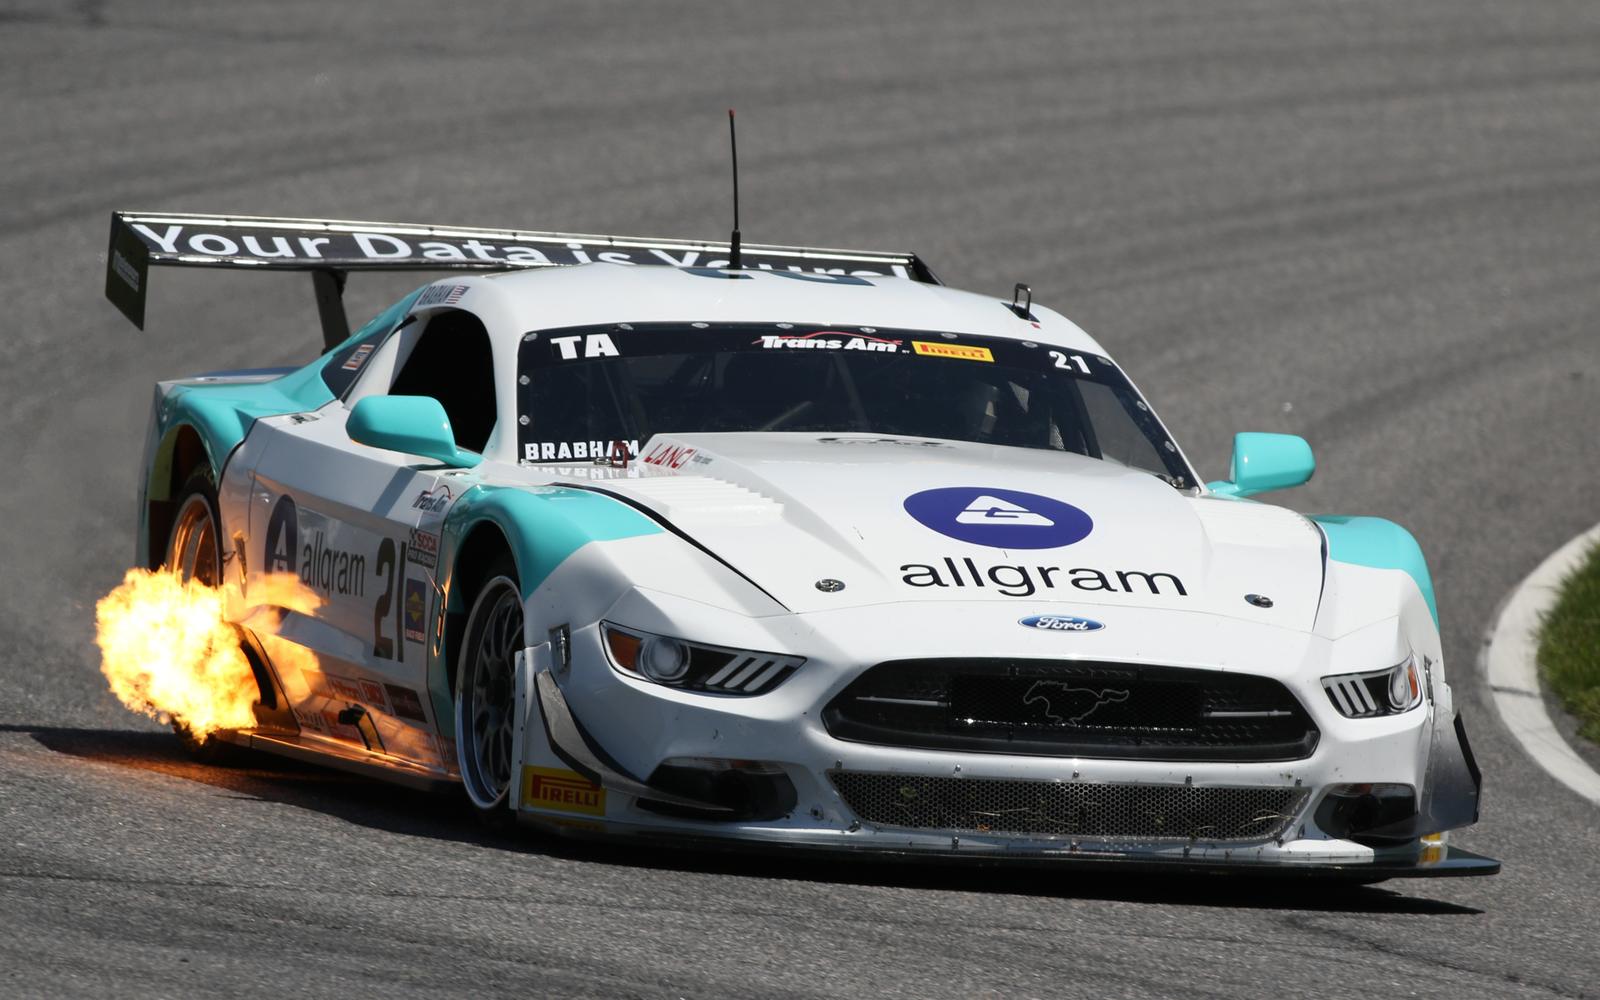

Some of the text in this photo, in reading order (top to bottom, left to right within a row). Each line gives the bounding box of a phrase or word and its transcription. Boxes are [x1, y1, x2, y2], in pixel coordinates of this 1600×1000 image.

[131, 223, 330, 258] Your
[353, 233, 552, 265] Data
[551, 333, 619, 359] TA
[761, 336, 897, 352] Trans Am
[920, 344, 985, 358] PIRELLI
[1049, 351, 1091, 374] 21
[525, 440, 638, 460] BRABHAM
[301, 531, 366, 597] allgram
[900, 557, 1187, 597] allgram
[374, 537, 407, 662] 21
[1036, 616, 1088, 629] Ford
[532, 774, 600, 807] PIRELLI
